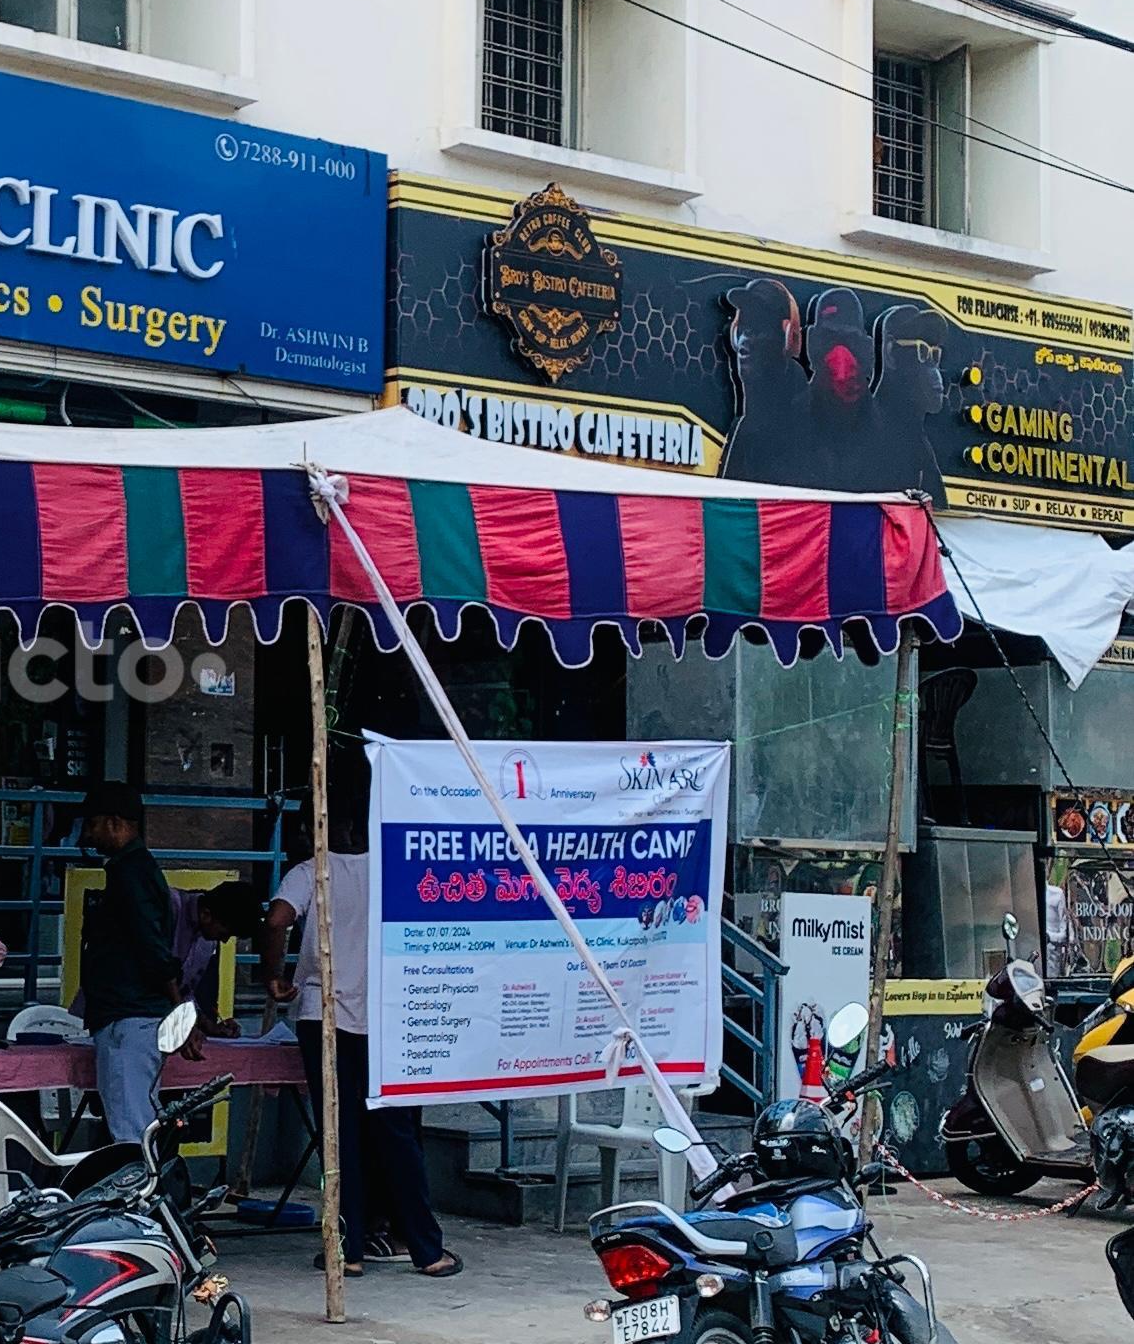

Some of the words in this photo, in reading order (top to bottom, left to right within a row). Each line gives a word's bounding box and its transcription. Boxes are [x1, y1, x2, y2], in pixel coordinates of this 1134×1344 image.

[241, 140, 356, 181] 7288-911-000
[518, 216, 542, 242] RETRO
[543, 213, 572, 230] COFFEE
[574, 228, 592, 254] CLUB
[957, 294, 973, 315] FOR
[974, 298, 1019, 323] FRANCHISE
[81, 285, 226, 356] Surgery
[260, 321, 278, 341] Dr.
[285, 327, 355, 351] ASHWINI
[357, 337, 369, 353] B
[275, 346, 367, 376] Dermatologist
[986, 402, 1074, 443] GAMING
[487, 397, 574, 451] BISTRO
[579, 410, 704, 467] CAFETERIA
[986, 441, 1134, 490] CONTINENTAL
[966, 492, 997, 509] CHEW
[1012, 497, 1031, 511] SUP
[1046, 501, 1077, 518] RELAX
[1092, 507, 1124, 523] REPEAT
[618, 757, 666, 791] SKIN
[668, 767, 706, 791] ARC
[410, 785, 423, 796] On
[424, 786, 438, 796] the
[440, 786, 482, 797] Occasion
[550, 788, 597, 801] Anniversary
[405, 831, 466, 861] FREE
[546, 832, 628, 861] HEALTH
[631, 830, 696, 860] CAMP
[404, 928, 425, 937] Date:
[1082, 926, 1120, 941] INDIAN
[404, 942, 430, 953] Timing:
[432, 942, 461, 952] 9:00AM
[468, 941, 496, 951] 2:00PM
[530, 939, 539, 949] Dr
[832, 946, 841, 955] ICE
[842, 946, 864, 955] CREAM
[404, 966, 420, 975] Free
[422, 965, 474, 975] Consultations
[566, 962, 579, 971] Our
[620, 959, 628, 967] Of
[408, 984, 440, 994] General
[442, 984, 479, 995] Physician
[885, 992, 911, 1001] Lovers
[914, 991, 927, 1003] Hop
[928, 991, 937, 1000] in
[937, 991, 945, 1000] to
[946, 990, 975, 1002] Explore
[408, 1001, 452, 1012] Cardiology
[408, 1017, 439, 1027] General
[440, 1016, 471, 1028] Surgery
[407, 1033, 458, 1044] Dermatology
[407, 1049, 450, 1059] Paediatrics
[497, 1058, 511, 1070] For
[513, 1054, 573, 1072] Appointments
[574, 1054, 591, 1065] Call:
[407, 1065, 432, 1075] Dental
[623, 1303, 670, 1326] TS08H
[624, 1318, 670, 1342] E7844
